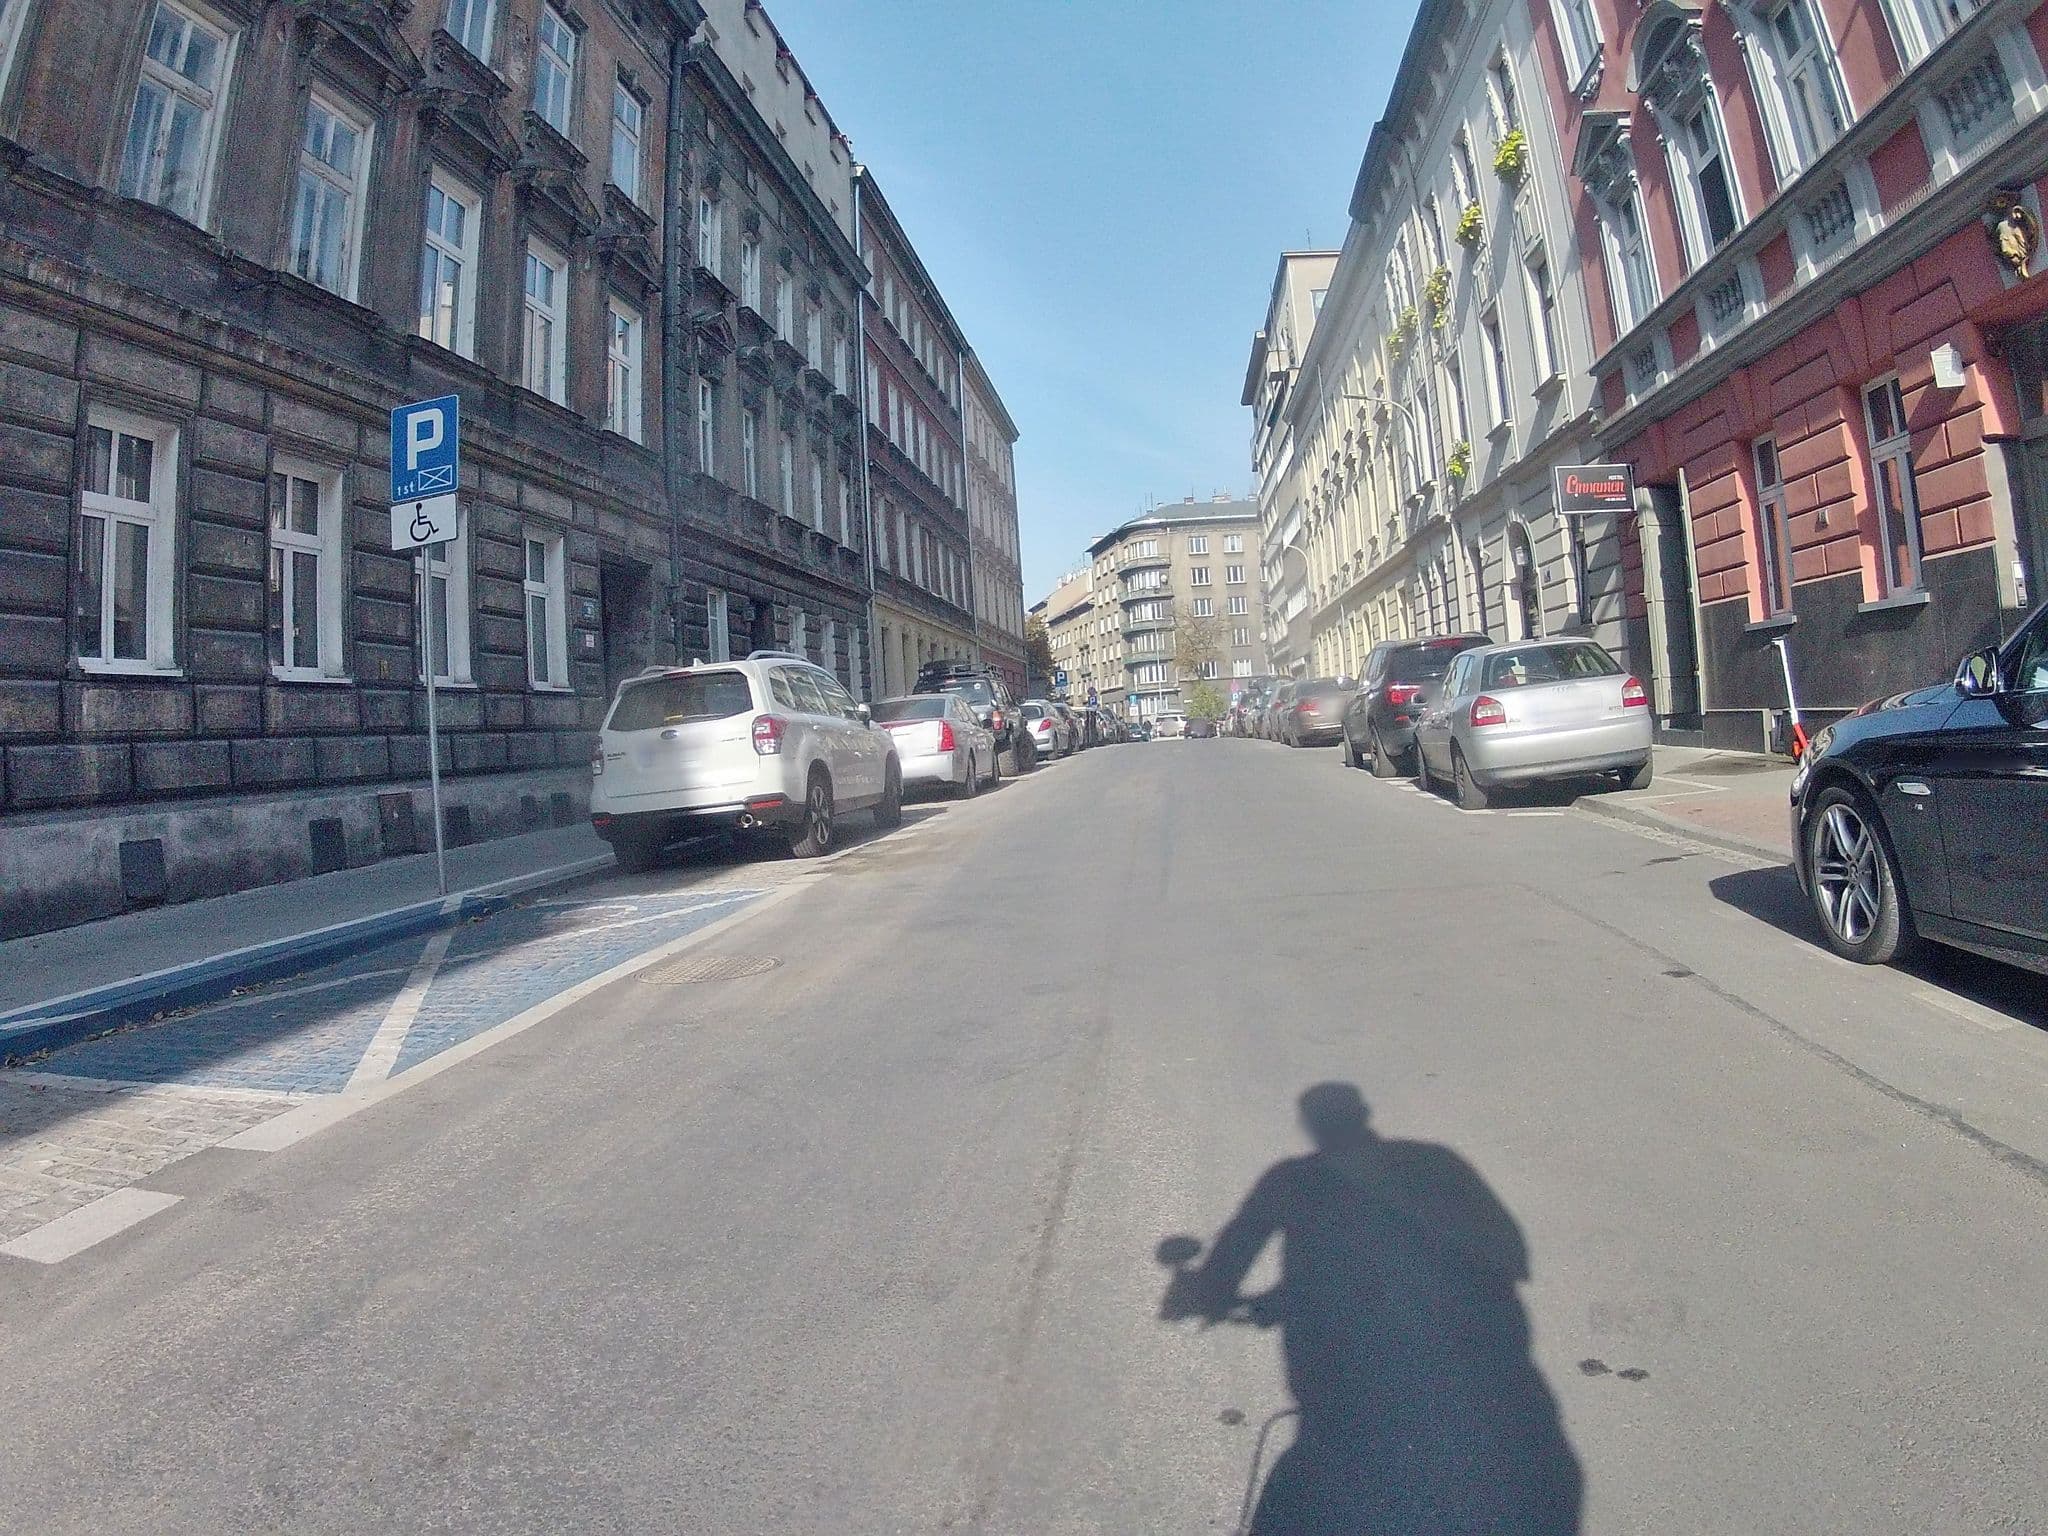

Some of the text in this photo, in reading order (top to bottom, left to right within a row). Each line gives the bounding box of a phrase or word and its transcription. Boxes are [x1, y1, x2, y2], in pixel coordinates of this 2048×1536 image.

[407, 408, 444, 471] P
[1566, 474, 1625, 494] Cinnamon
[1057, 671, 1065, 682] P
